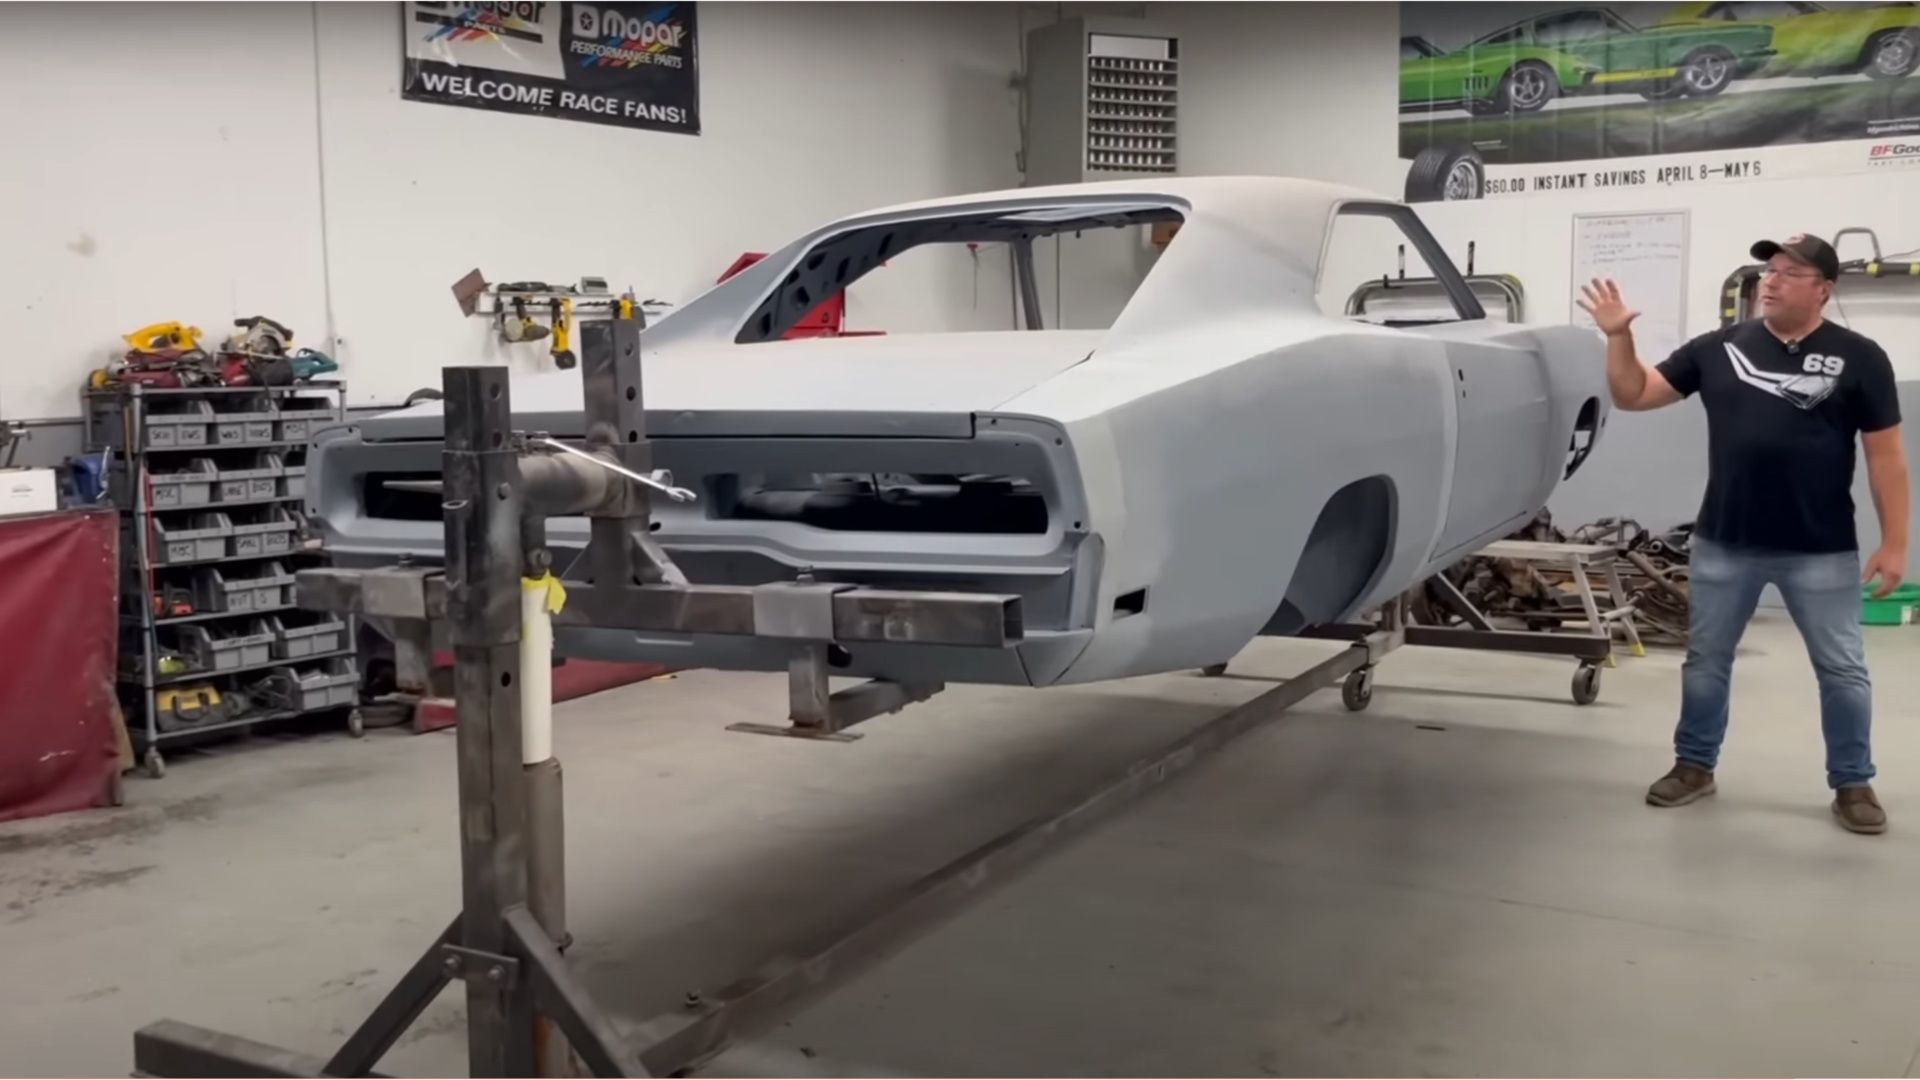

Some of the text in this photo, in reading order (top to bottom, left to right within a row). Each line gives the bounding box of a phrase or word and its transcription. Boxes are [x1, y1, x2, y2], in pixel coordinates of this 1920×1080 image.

[570, 41, 682, 69] PERFORMANCE PARTS
[422, 72, 687, 123] WELCOME RACE FANS!
[1485, 178, 1525, 194] $60.00
[1534, 173, 1587, 191] INSTANT
[1594, 170, 1646, 187] SAVINGS
[1657, 166, 1694, 183] APRIL
[1802, 354, 1844, 376] 69
